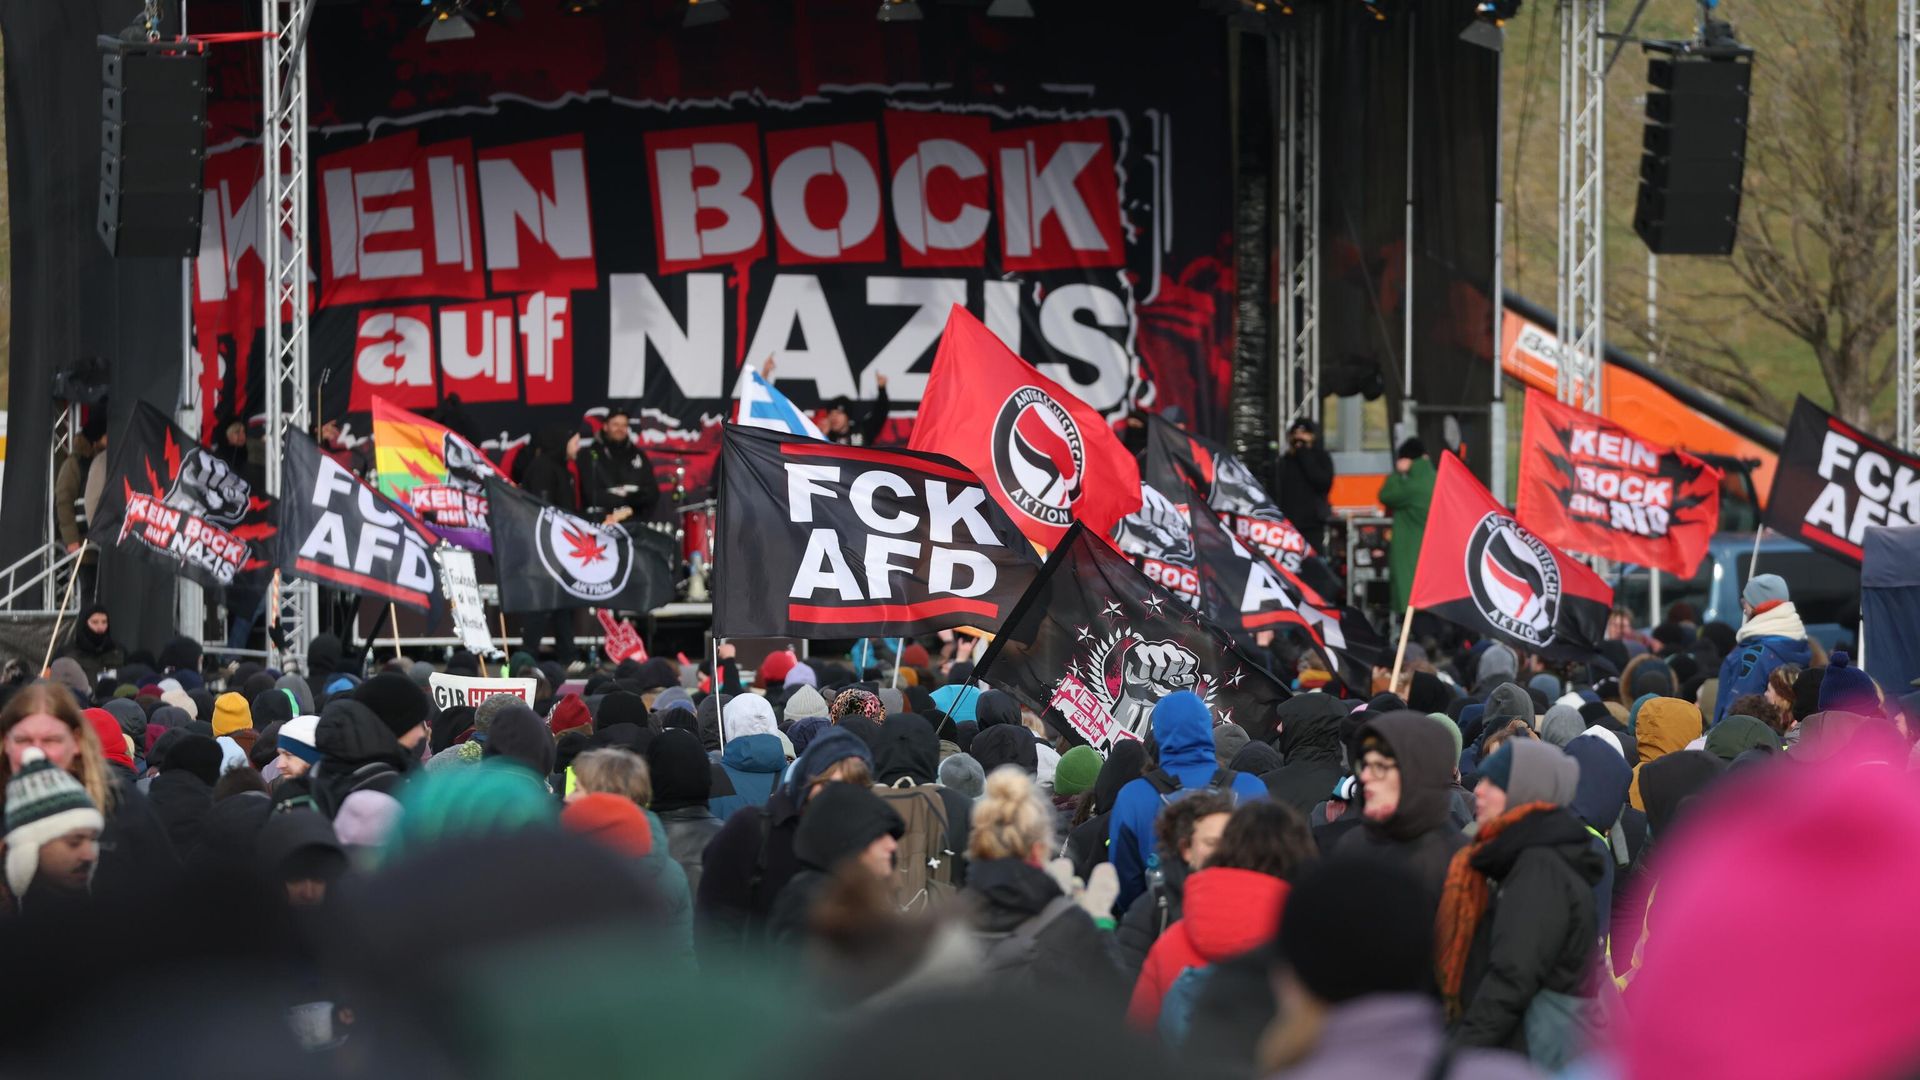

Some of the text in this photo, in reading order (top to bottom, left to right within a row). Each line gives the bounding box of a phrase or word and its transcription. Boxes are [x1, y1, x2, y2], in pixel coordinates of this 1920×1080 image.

[196, 139, 1109, 302] KEIN BOCK
[356, 291, 567, 385] auf
[1571, 429, 1657, 469] KEIN
[784, 462, 1003, 546] FCK
[1010, 488, 1069, 523] AKTION
[1575, 466, 1671, 506] BOCK
[129, 498, 242, 562] KEIN BOCK
[145, 523, 235, 584] auf NAZIS
[299, 510, 434, 593] AFD
[1236, 518, 1301, 551] BOCK
[789, 528, 998, 601] AFD
[435, 685, 466, 708] GIB
[1060, 678, 1113, 735] KEIN
